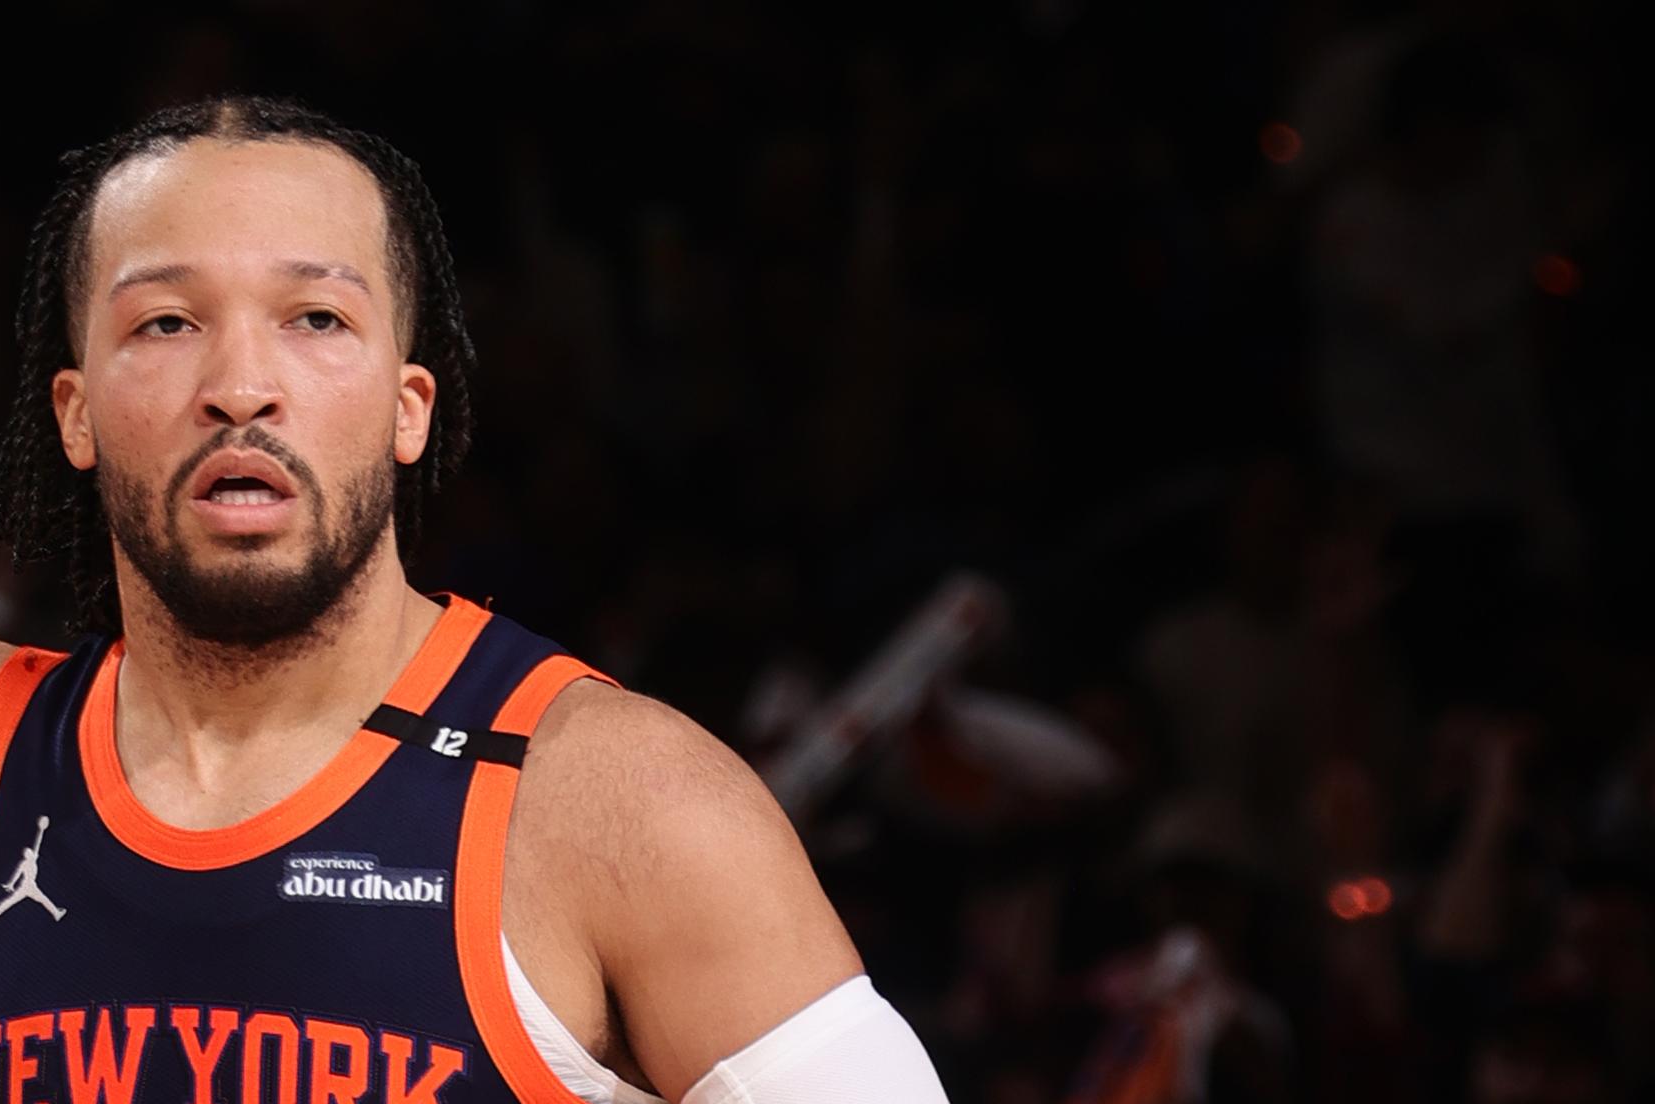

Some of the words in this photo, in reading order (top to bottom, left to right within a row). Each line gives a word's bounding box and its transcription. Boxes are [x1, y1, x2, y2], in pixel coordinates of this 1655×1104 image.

[430, 727, 468, 757] 12
[289, 856, 375, 872] experience
[283, 871, 346, 898] abu
[350, 873, 445, 903] dhabi
